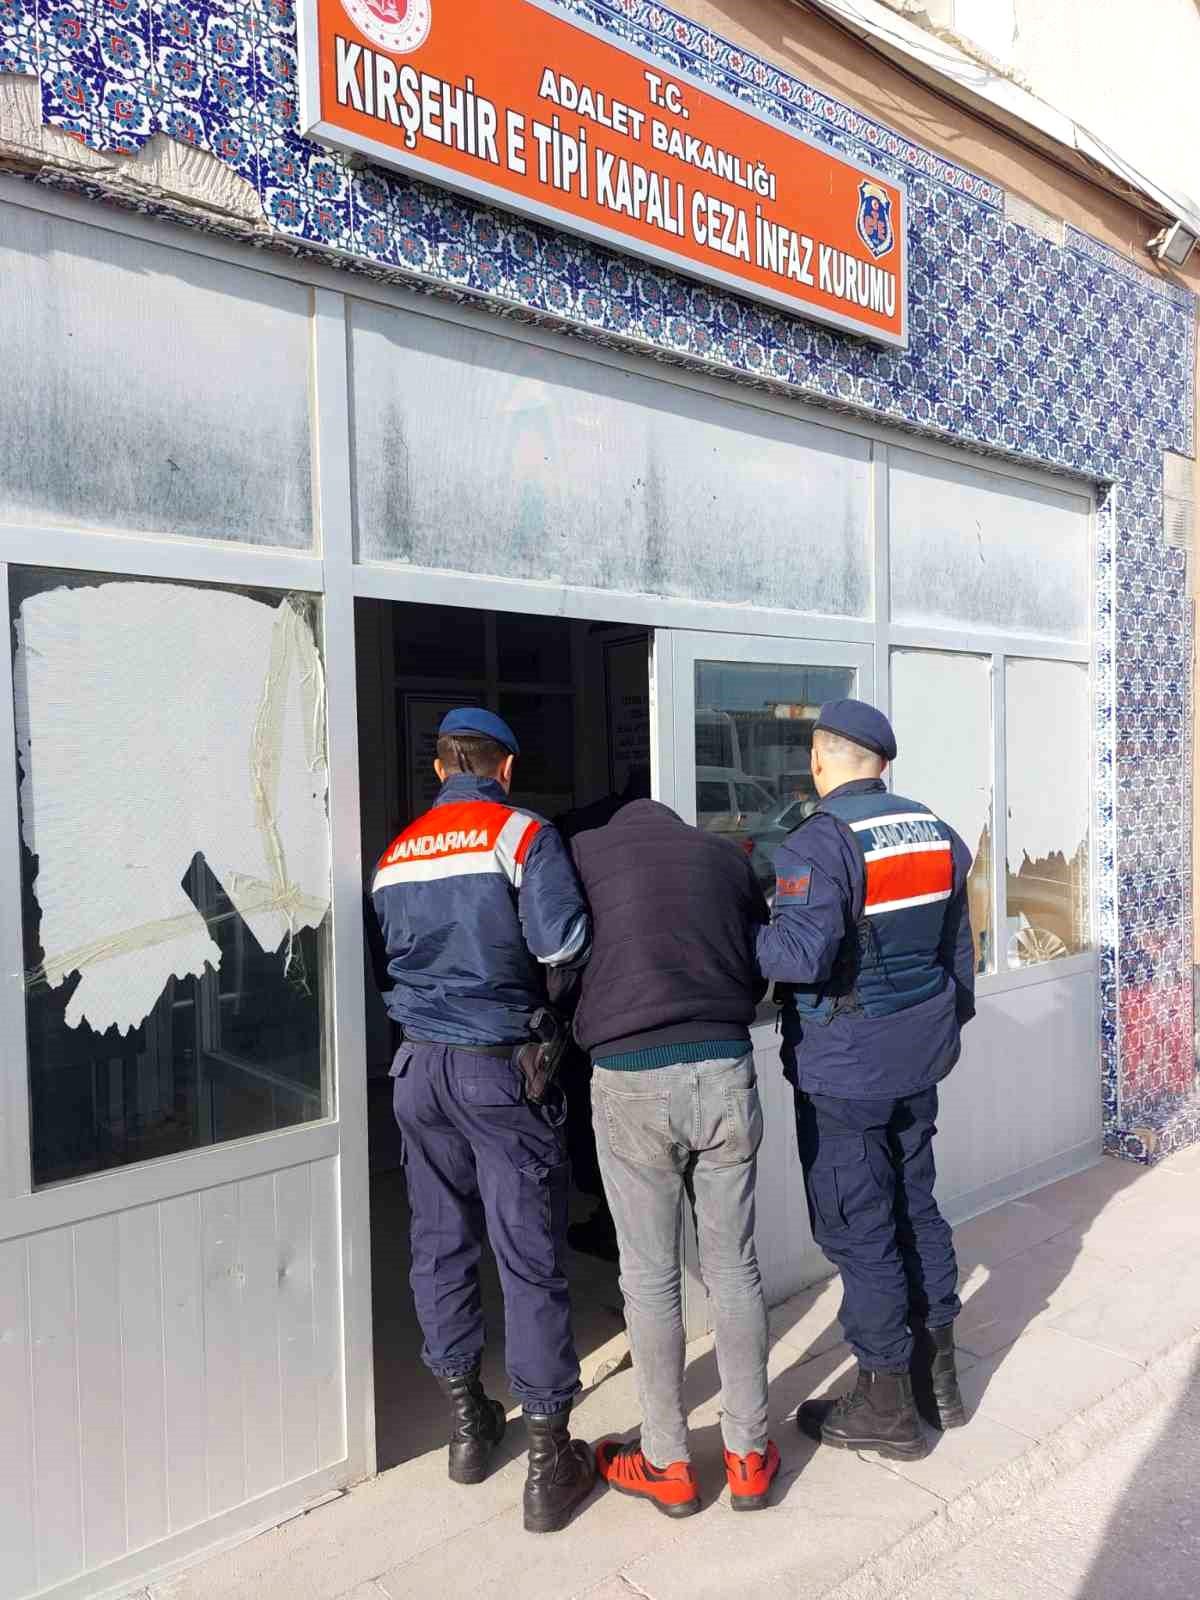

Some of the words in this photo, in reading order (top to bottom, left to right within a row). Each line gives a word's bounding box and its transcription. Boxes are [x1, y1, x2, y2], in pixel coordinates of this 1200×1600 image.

[643, 70, 689, 119] T.C.
[538, 66, 645, 141] ADALET
[651, 116, 777, 201] BAKANLIĞI
[335, 34, 500, 166] KIRŞEHİR
[505, 108, 527, 176] E
[532, 113, 589, 200] TİPİ
[595, 147, 685, 238] KAPALI
[691, 189, 751, 263] CEZA
[755, 204, 814, 288] İNFAZ
[819, 241, 896, 318] KURUMU
[386, 829, 488, 863] JANDARMA
[870, 820, 942, 850] JANDARMA
